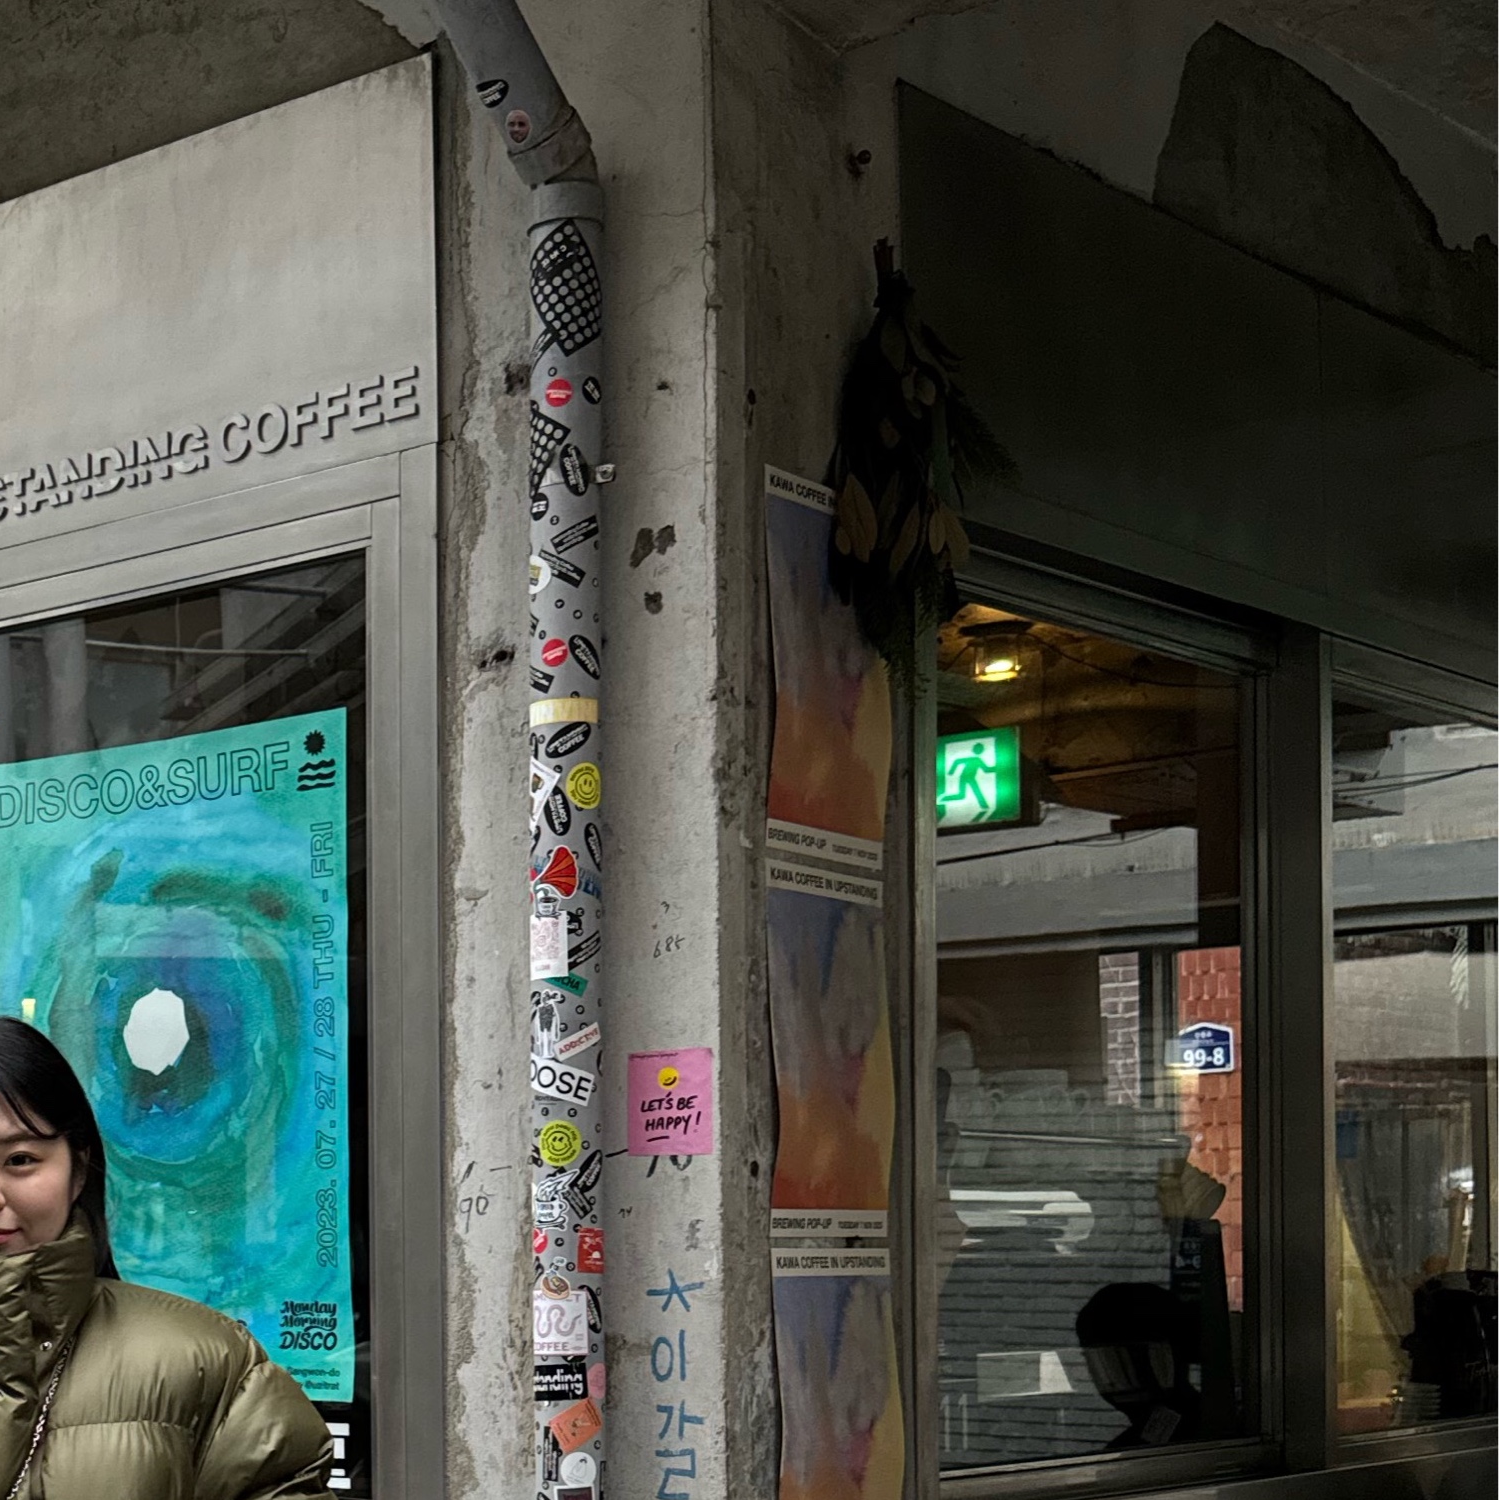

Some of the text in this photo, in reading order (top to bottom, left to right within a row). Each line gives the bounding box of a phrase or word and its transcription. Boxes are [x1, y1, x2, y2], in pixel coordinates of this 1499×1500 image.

[222, 366, 420, 463] COFFEE
[769, 473, 794, 494] KAWA
[796, 484, 826, 505] COFFEE
[558, 734, 584, 753] COFFEE
[310, 821, 334, 878] FRI
[768, 828, 826, 850] BREWING POP-UP
[770, 867, 877, 900] KAWA COFFEE IN UPSTANDING
[312, 914, 335, 989] THU
[314, 995, 335, 1037] 28
[1183, 1047, 1225, 1067] 99-8
[315, 1072, 336, 1105] 27
[640, 1091, 698, 1113] LET'S BE
[316, 1179, 338, 1268] 2023.
[772, 1218, 805, 1229] BREWING
[807, 1218, 832, 1229] POP-UP
[776, 1256, 885, 1269] KAWA COFFEE IN UPSTANDING
[279, 1331, 337, 1350] DISCO
